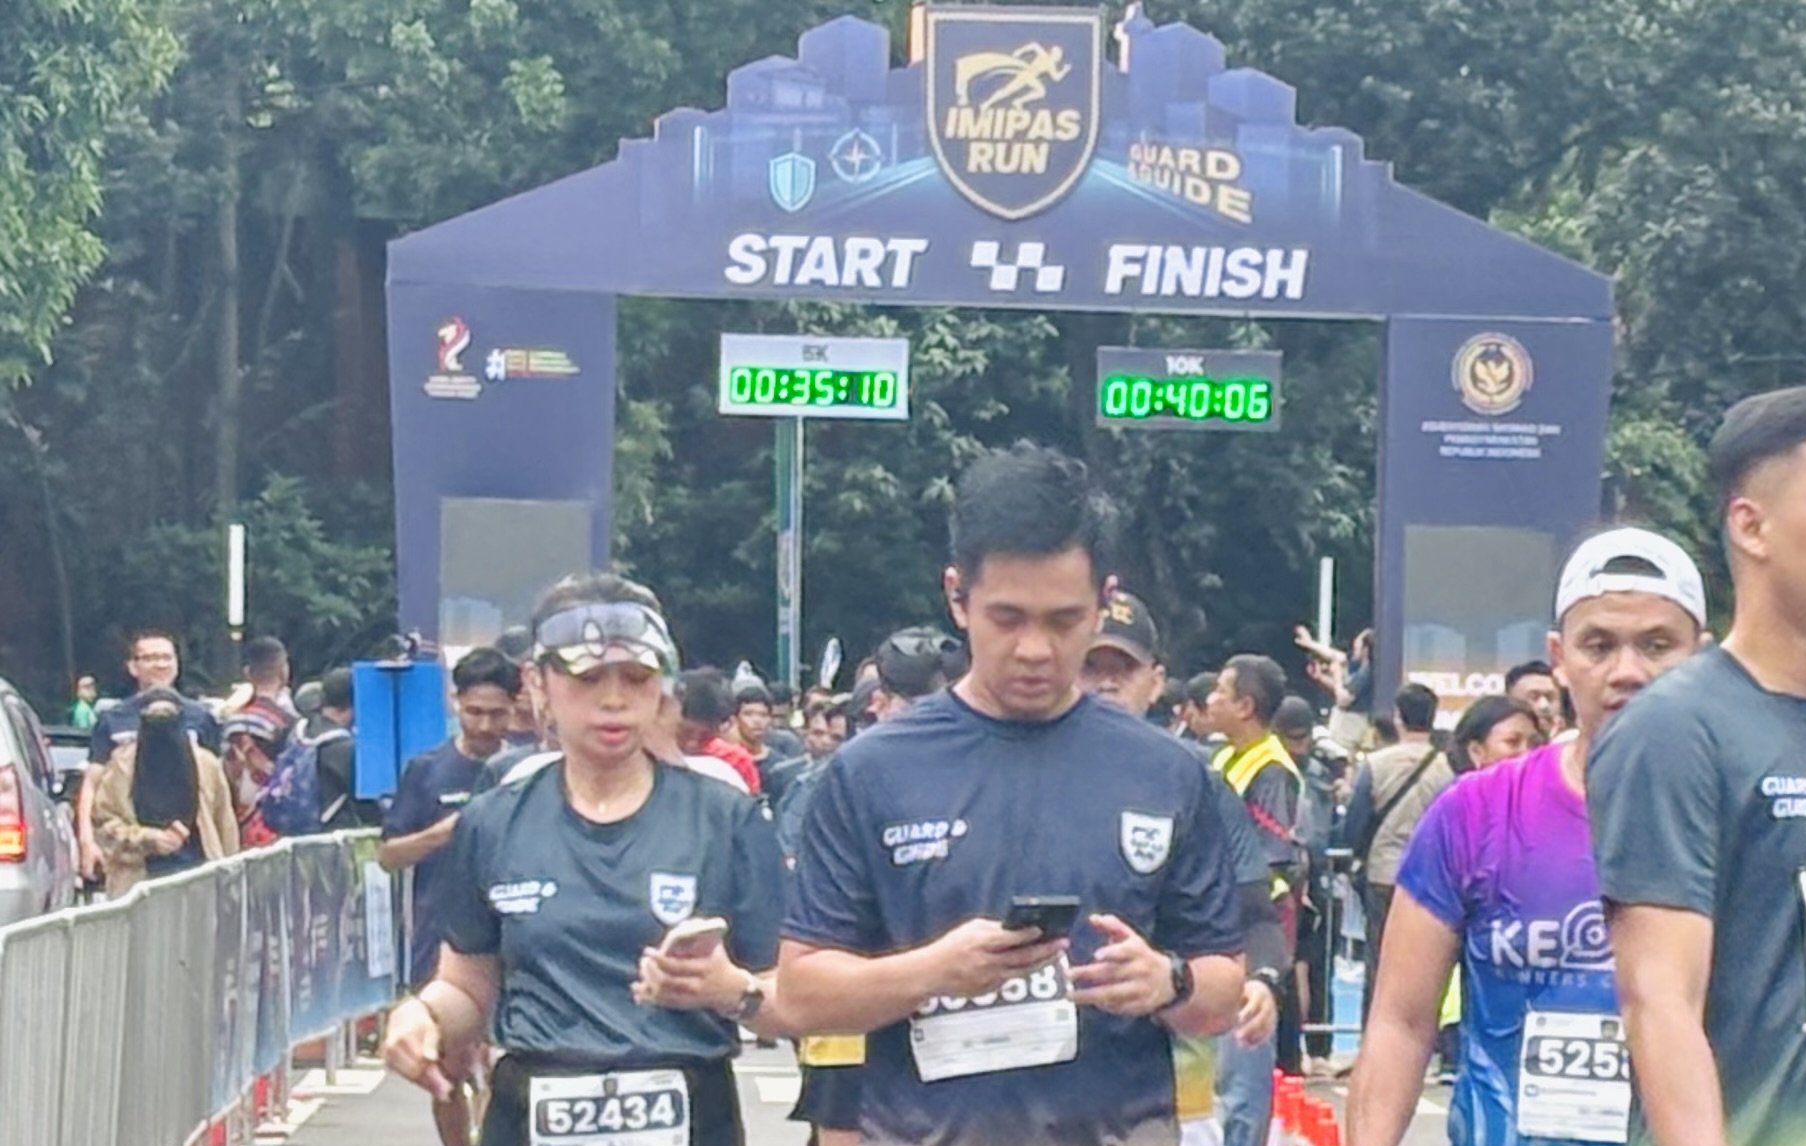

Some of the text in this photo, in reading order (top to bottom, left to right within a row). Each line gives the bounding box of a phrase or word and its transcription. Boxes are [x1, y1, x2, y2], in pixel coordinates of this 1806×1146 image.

[945, 107, 1081, 141] IMIPAS
[967, 142, 1048, 174] RUN
[1129, 143, 1241, 181] GUARD
[724, 233, 1309, 299] START FINISH
[1166, 355, 1205, 375] 10K
[731, 368, 896, 407] 00:35:10
[1106, 381, 1269, 420] 00:40:06
[882, 821, 949, 847] GUARD
[547, 1093, 675, 1134] 52434
